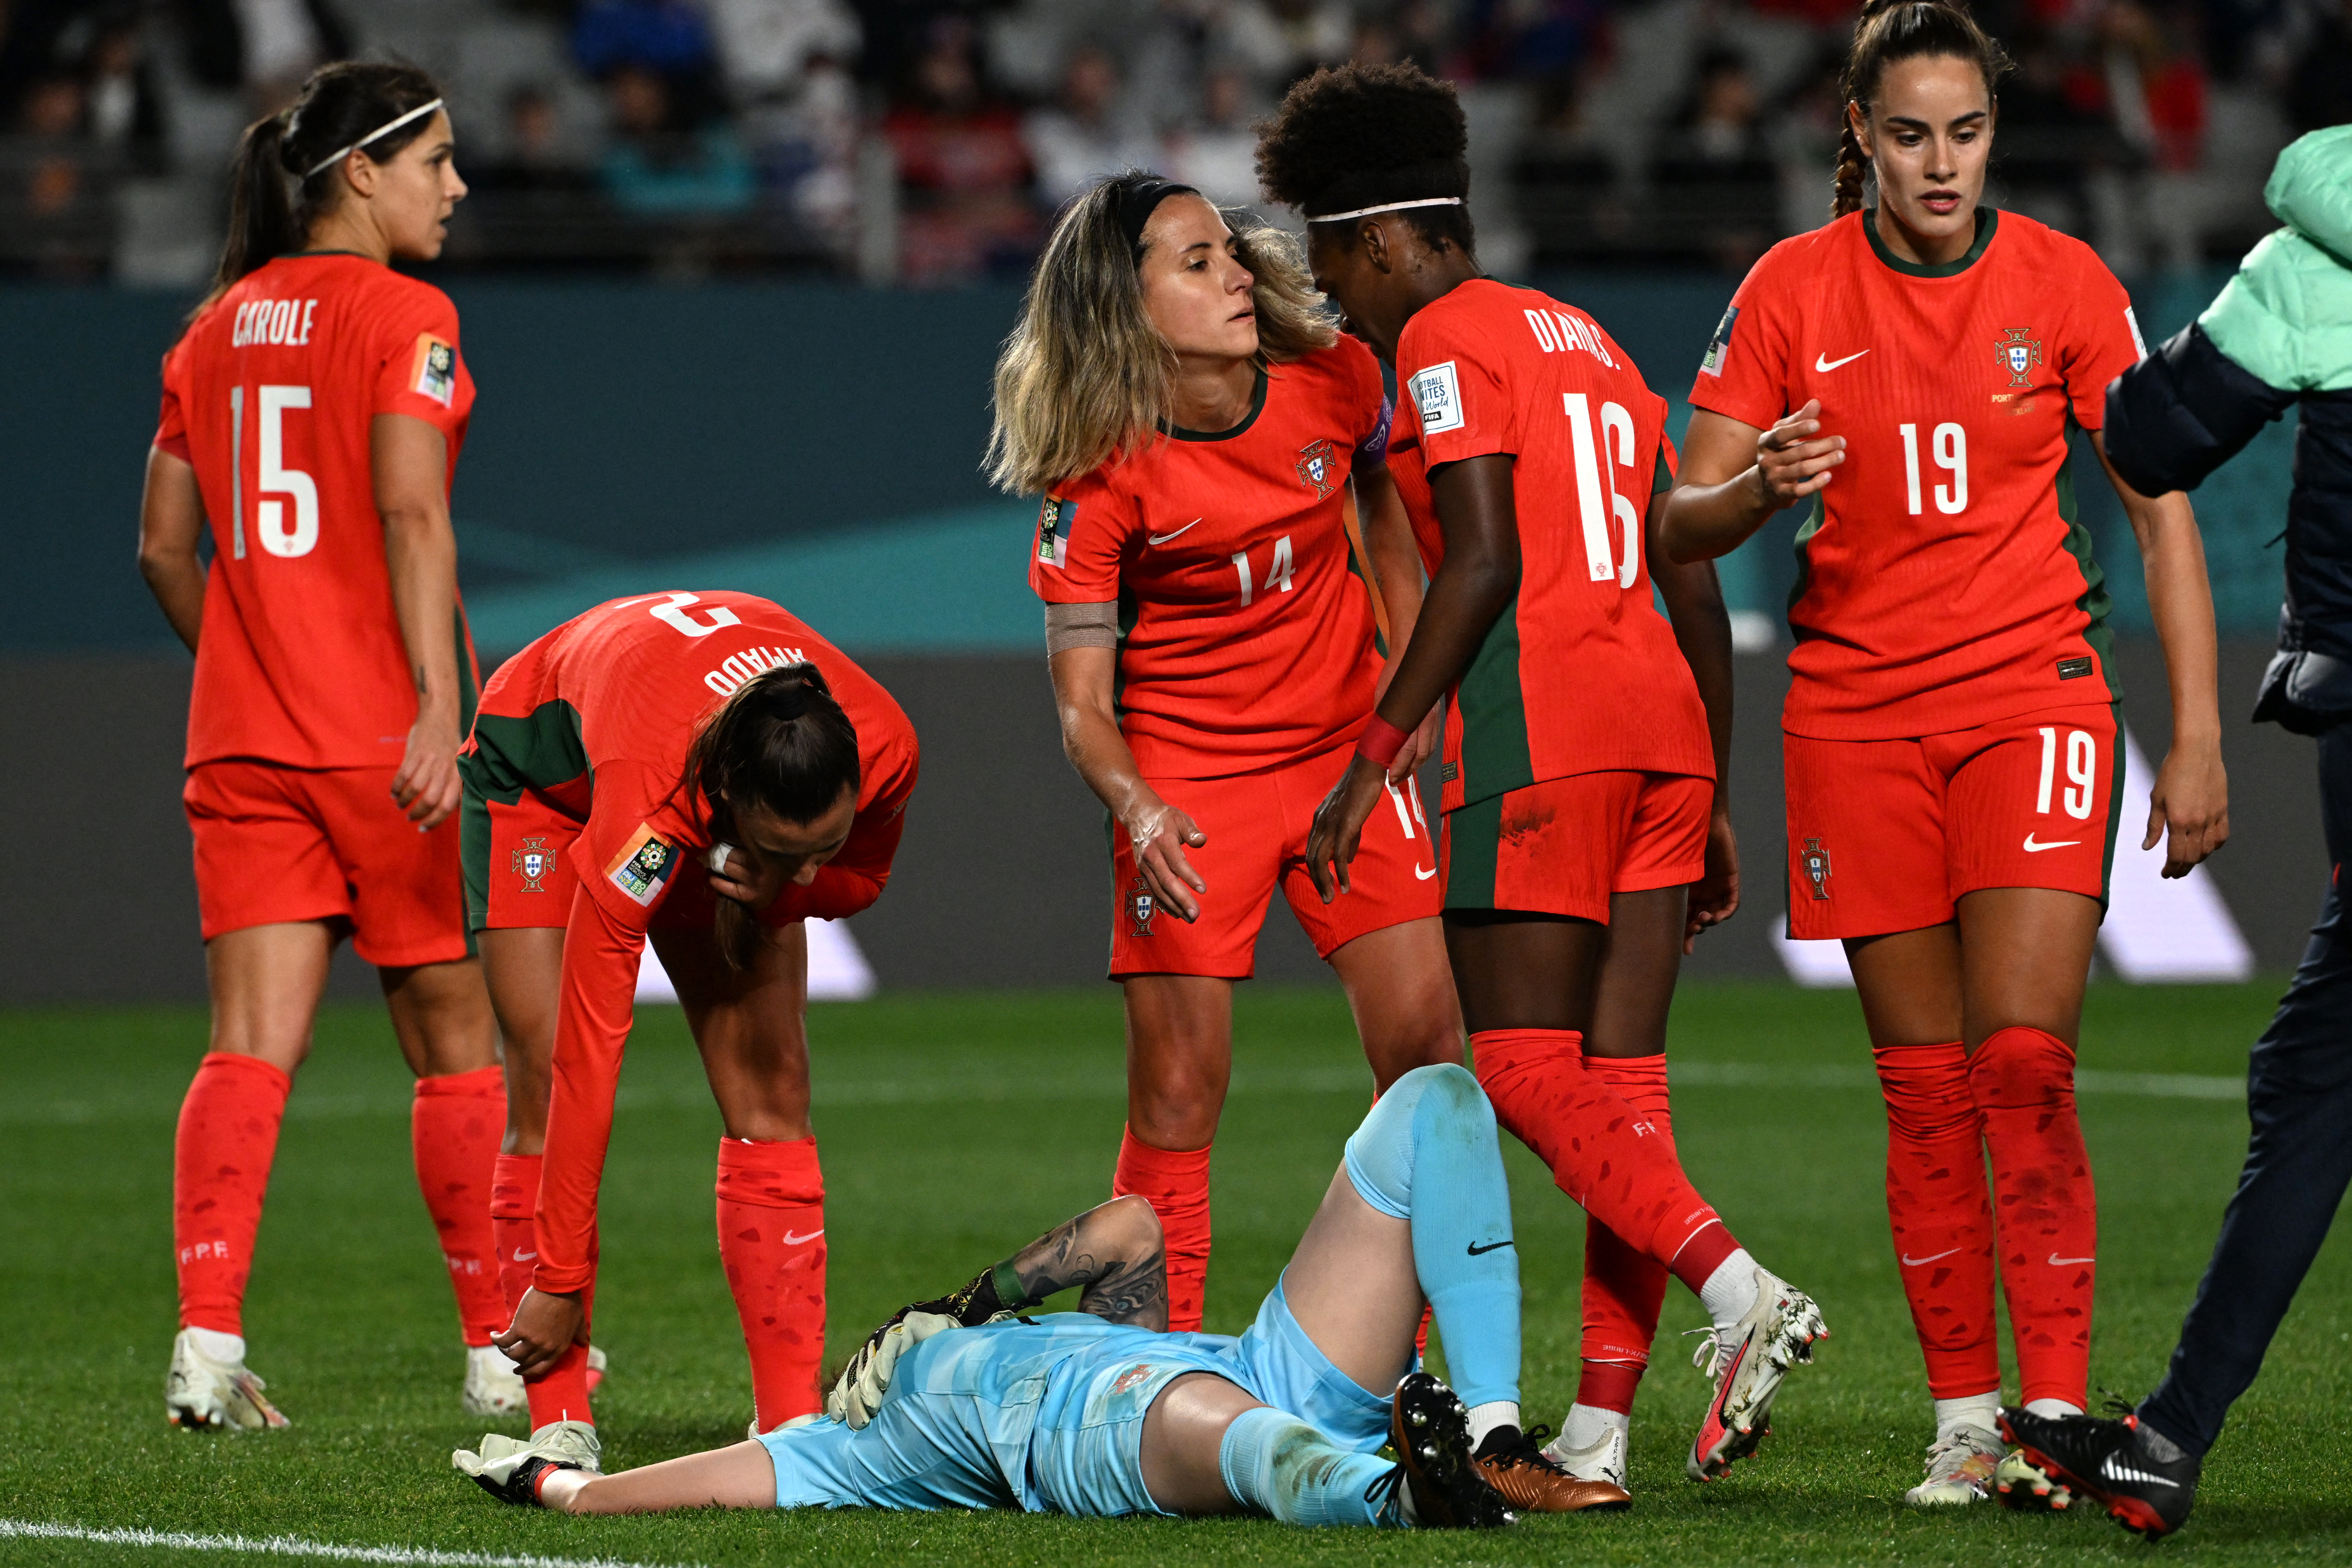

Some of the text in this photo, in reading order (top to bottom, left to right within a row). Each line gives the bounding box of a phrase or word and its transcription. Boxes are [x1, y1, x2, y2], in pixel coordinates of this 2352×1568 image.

[231, 299, 318, 348] CAROLE
[230, 384, 319, 560] 15
[1563, 393, 1638, 589] 16
[1900, 422, 1968, 515] 19
[1232, 535, 1296, 608] 14
[613, 593, 743, 637] 2
[2036, 727, 2096, 820] 19
[1385, 768, 1429, 843] 14
[619, 875, 631, 886] NZ
[622, 870, 636, 881] AU
[628, 866, 641, 877] WORLD
[630, 863, 646, 877] WOMEN'S
[632, 860, 641, 869] FIFA
